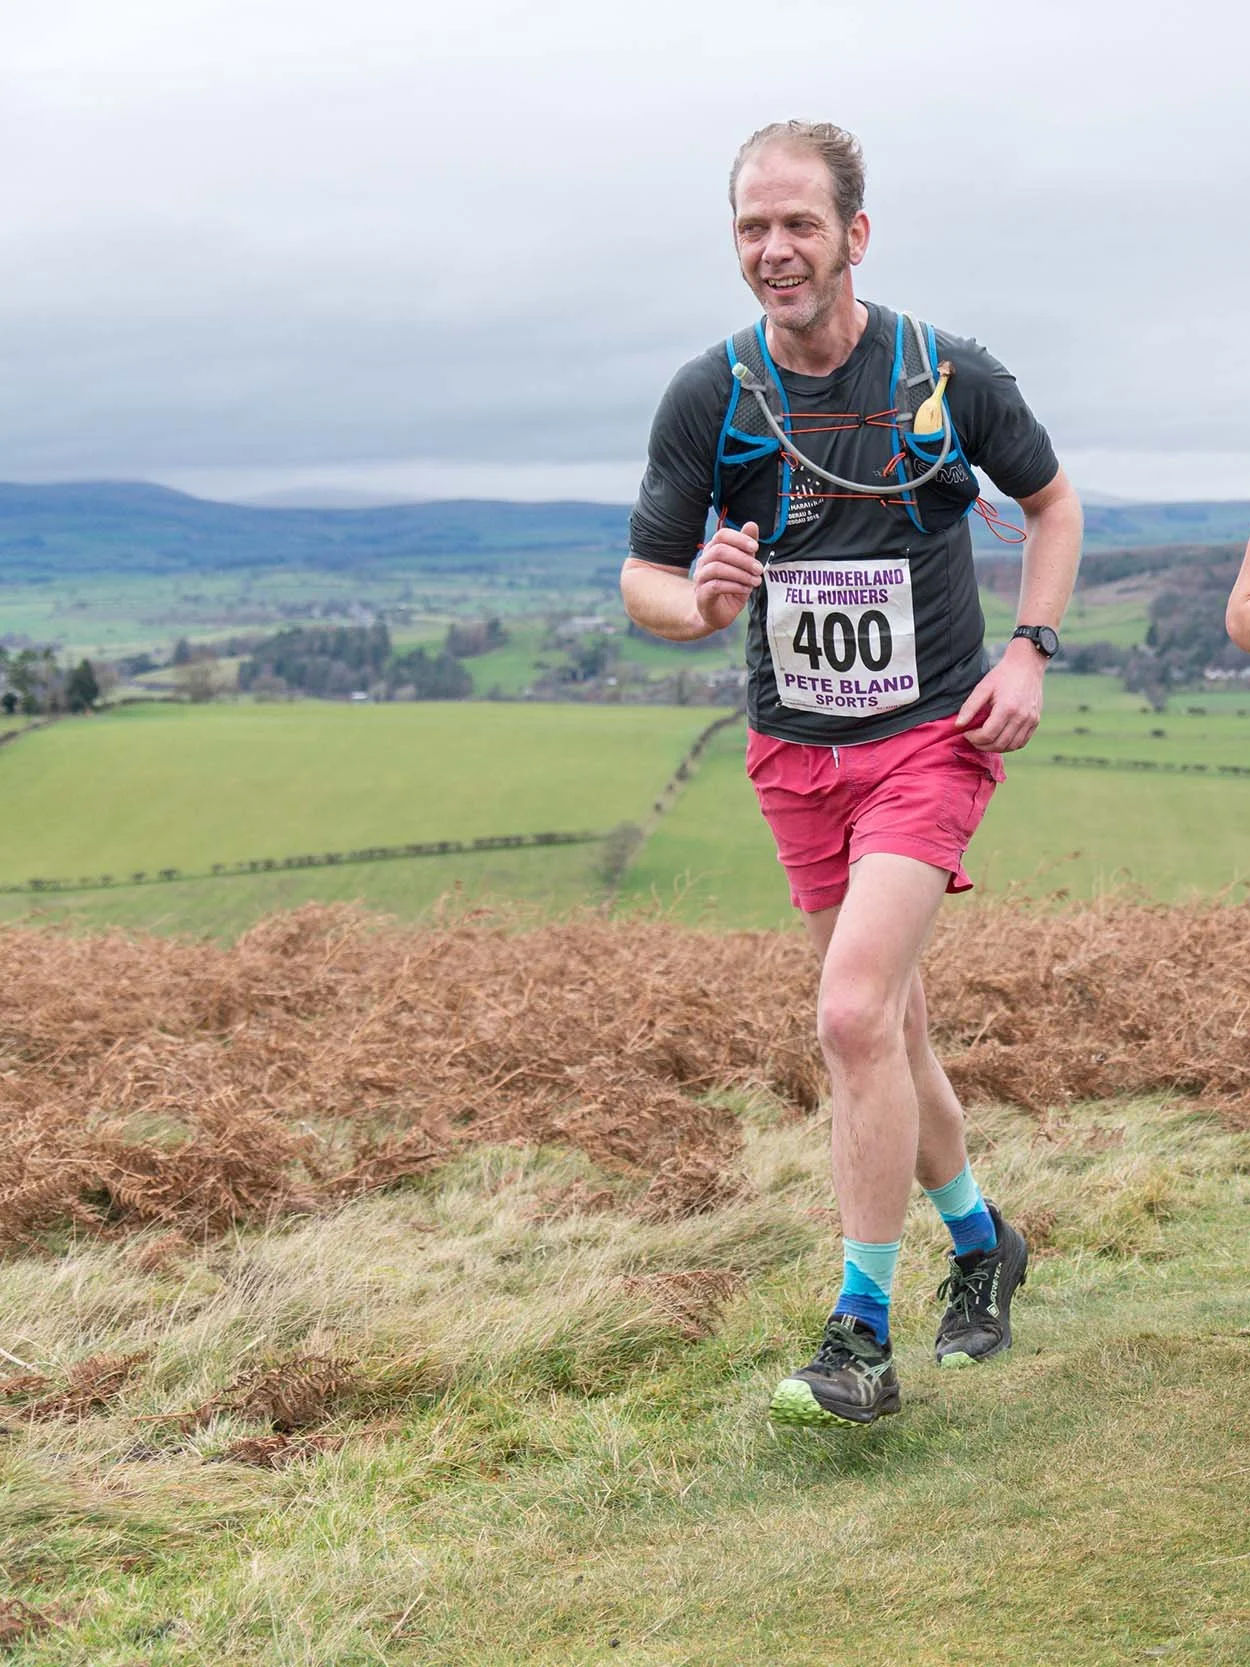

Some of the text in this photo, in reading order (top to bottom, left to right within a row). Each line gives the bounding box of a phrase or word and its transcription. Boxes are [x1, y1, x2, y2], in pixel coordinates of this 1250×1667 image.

[769, 568, 904, 587] NORTHUMBERLAND
[785, 588, 888, 606] FELL RUNNERS
[792, 609, 893, 673] 400
[784, 673, 914, 694] PETE BLAND
[815, 694, 878, 708] SPORTS
